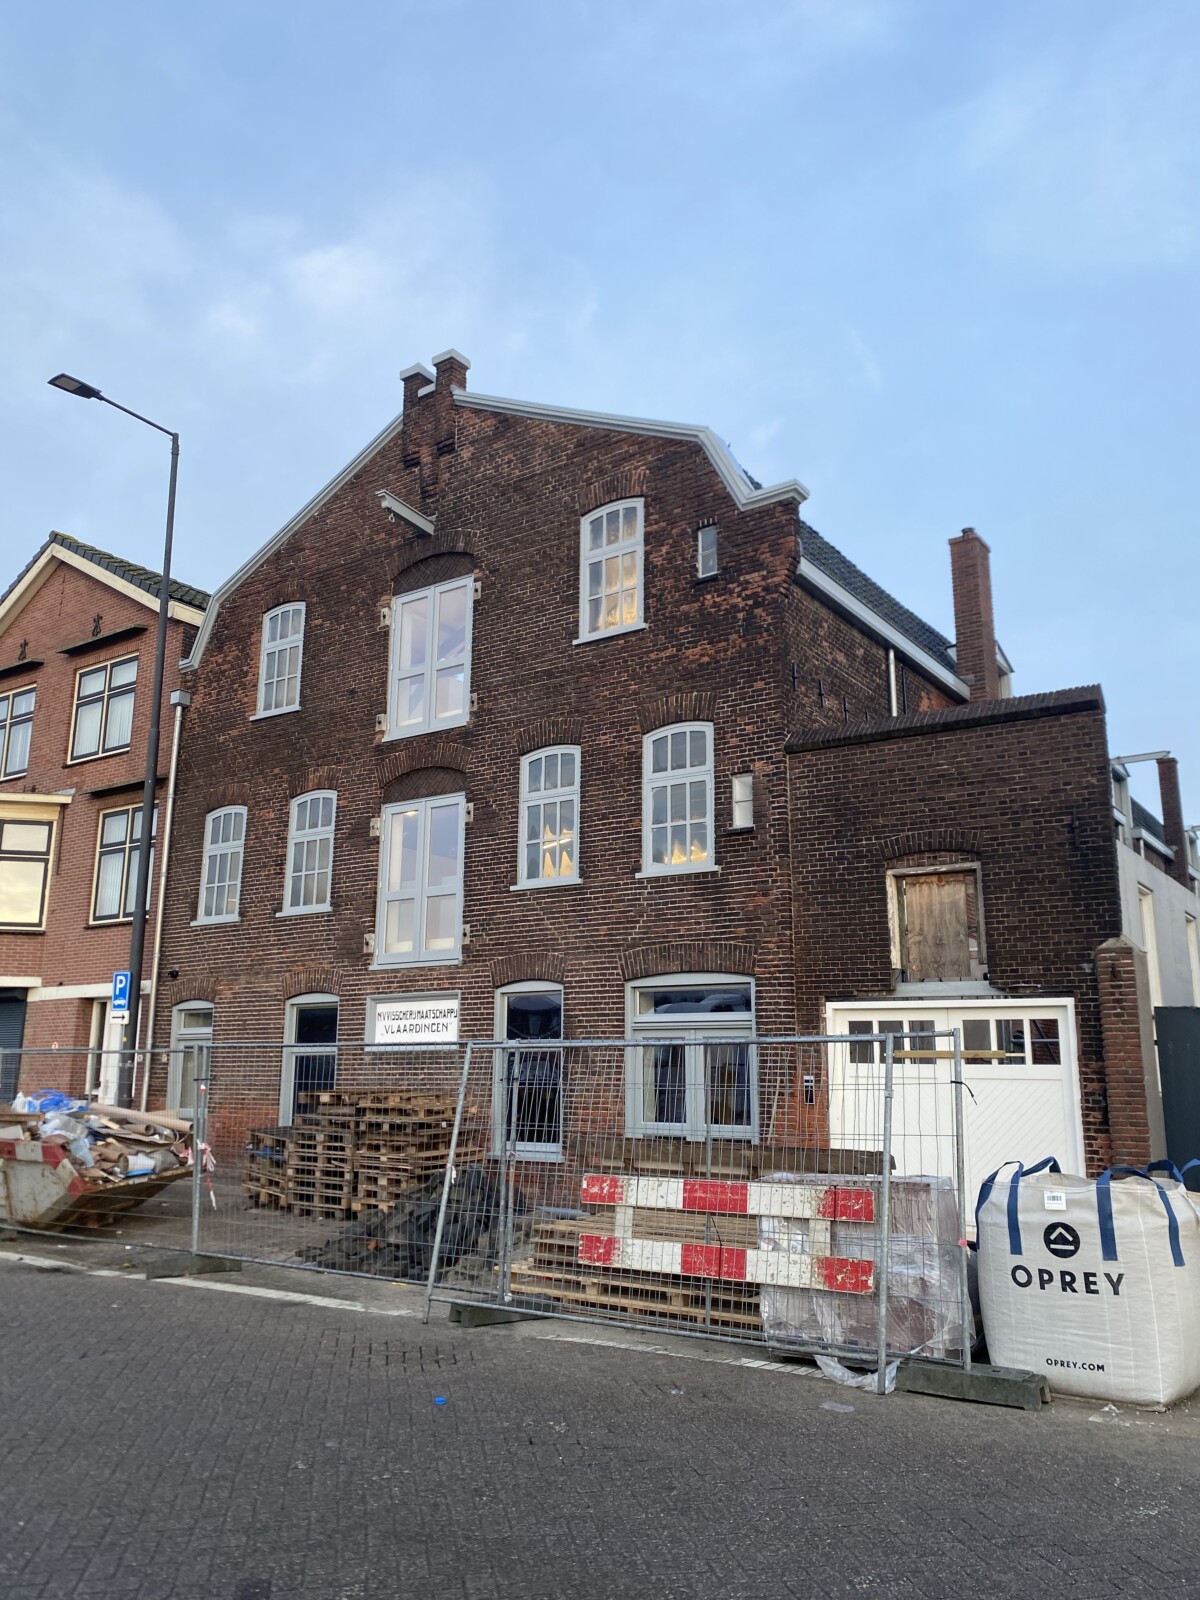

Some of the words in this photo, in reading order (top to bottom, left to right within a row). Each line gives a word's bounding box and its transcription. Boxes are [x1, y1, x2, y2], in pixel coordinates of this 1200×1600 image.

[115, 975, 126, 995] P
[1011, 1264, 1125, 1296] OPREY
[1046, 1358, 1105, 1372] OPREY.COM
